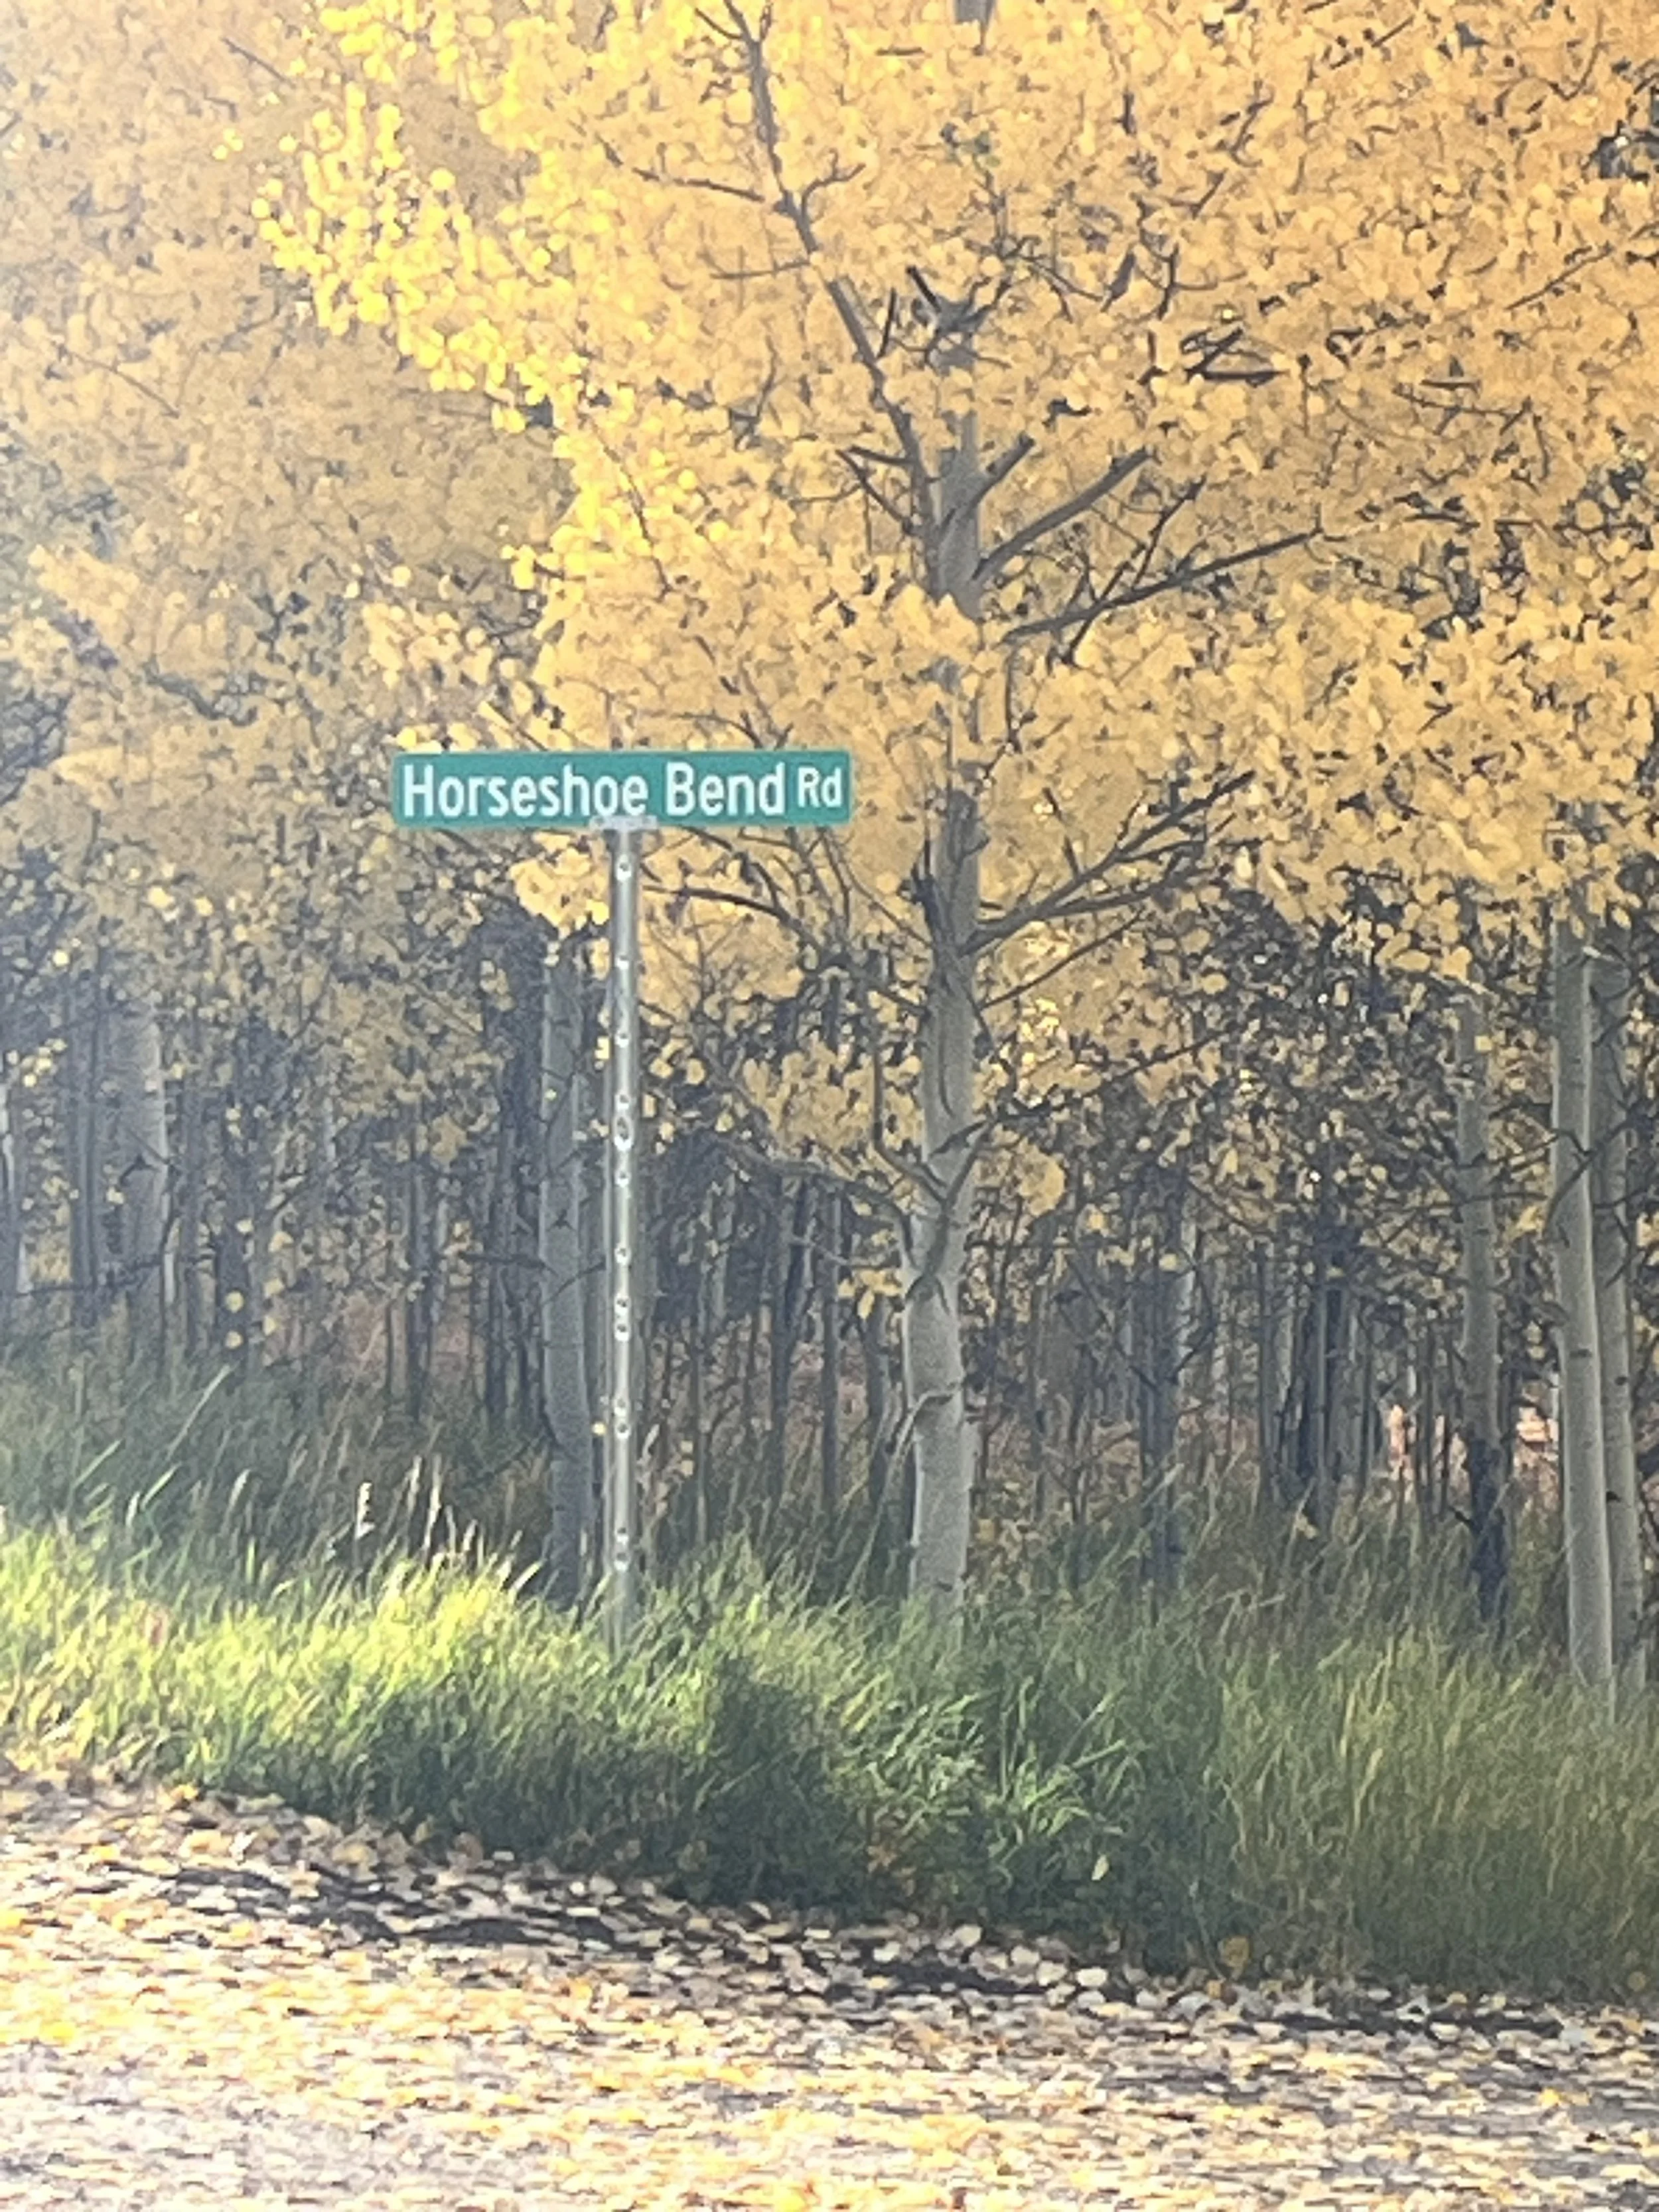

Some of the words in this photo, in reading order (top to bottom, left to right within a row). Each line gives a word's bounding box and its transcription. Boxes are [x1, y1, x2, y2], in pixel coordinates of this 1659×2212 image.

[403, 763, 648, 817] Horseshoe
[666, 762, 785, 816] Bend
[797, 767, 842, 807] Rd
